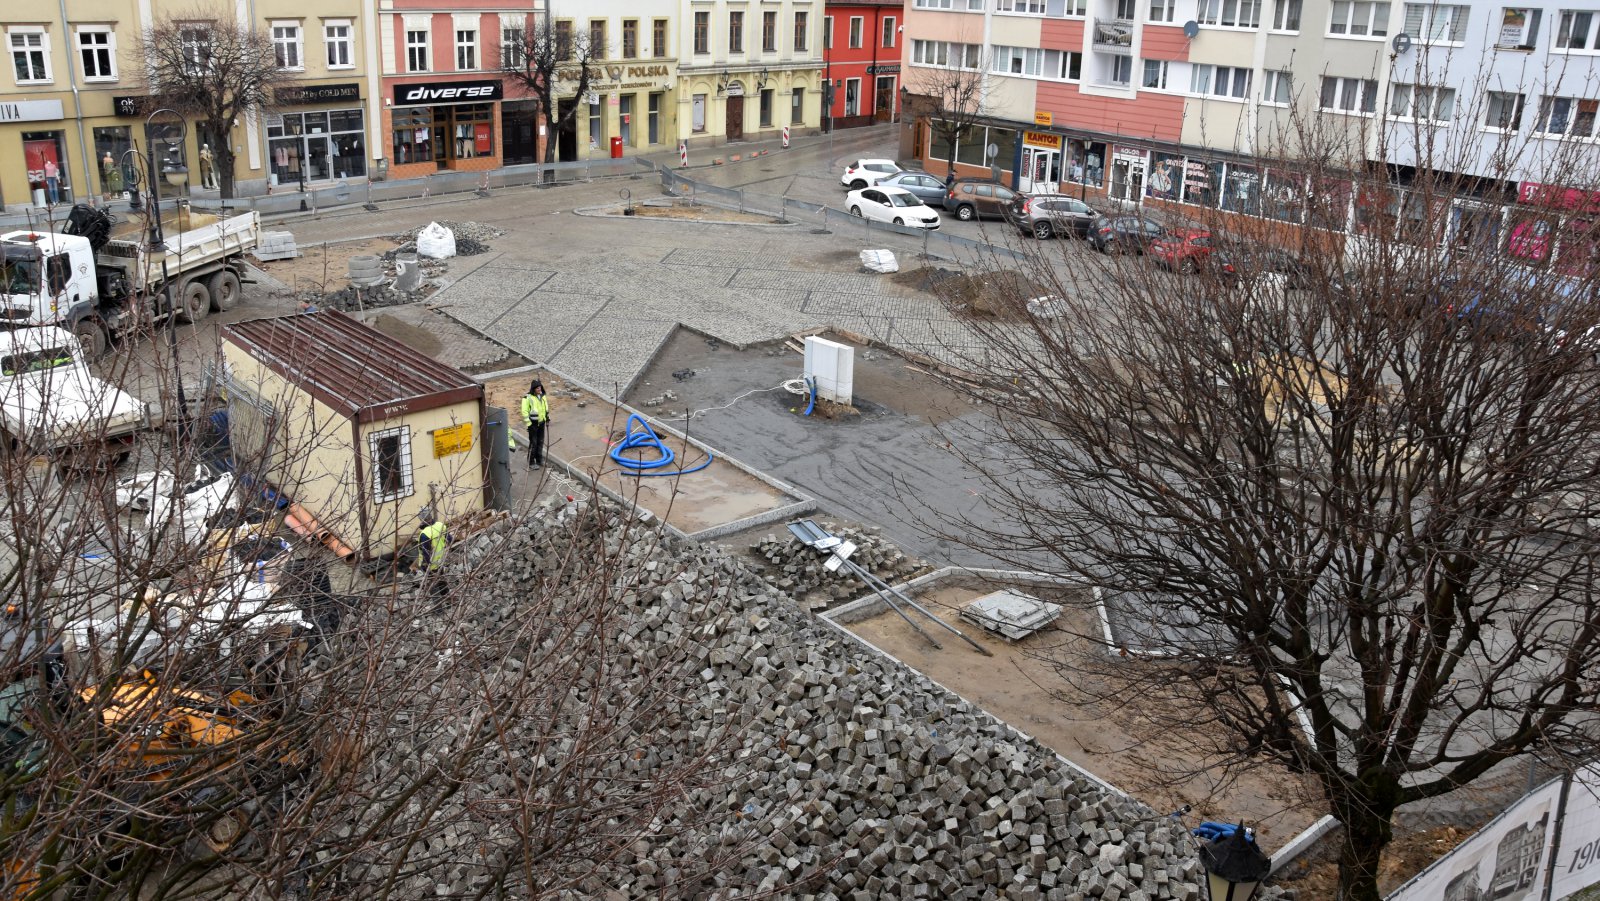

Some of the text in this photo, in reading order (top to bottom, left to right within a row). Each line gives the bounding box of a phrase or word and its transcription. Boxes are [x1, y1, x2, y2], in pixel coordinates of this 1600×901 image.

[628, 65, 669, 77] POLSKA
[319, 89, 340, 97] GOLD
[341, 88, 357, 96] MEN
[406, 87, 495, 100] diverse
[121, 98, 134, 106] ok
[1027, 132, 1058, 145] KANTOR
